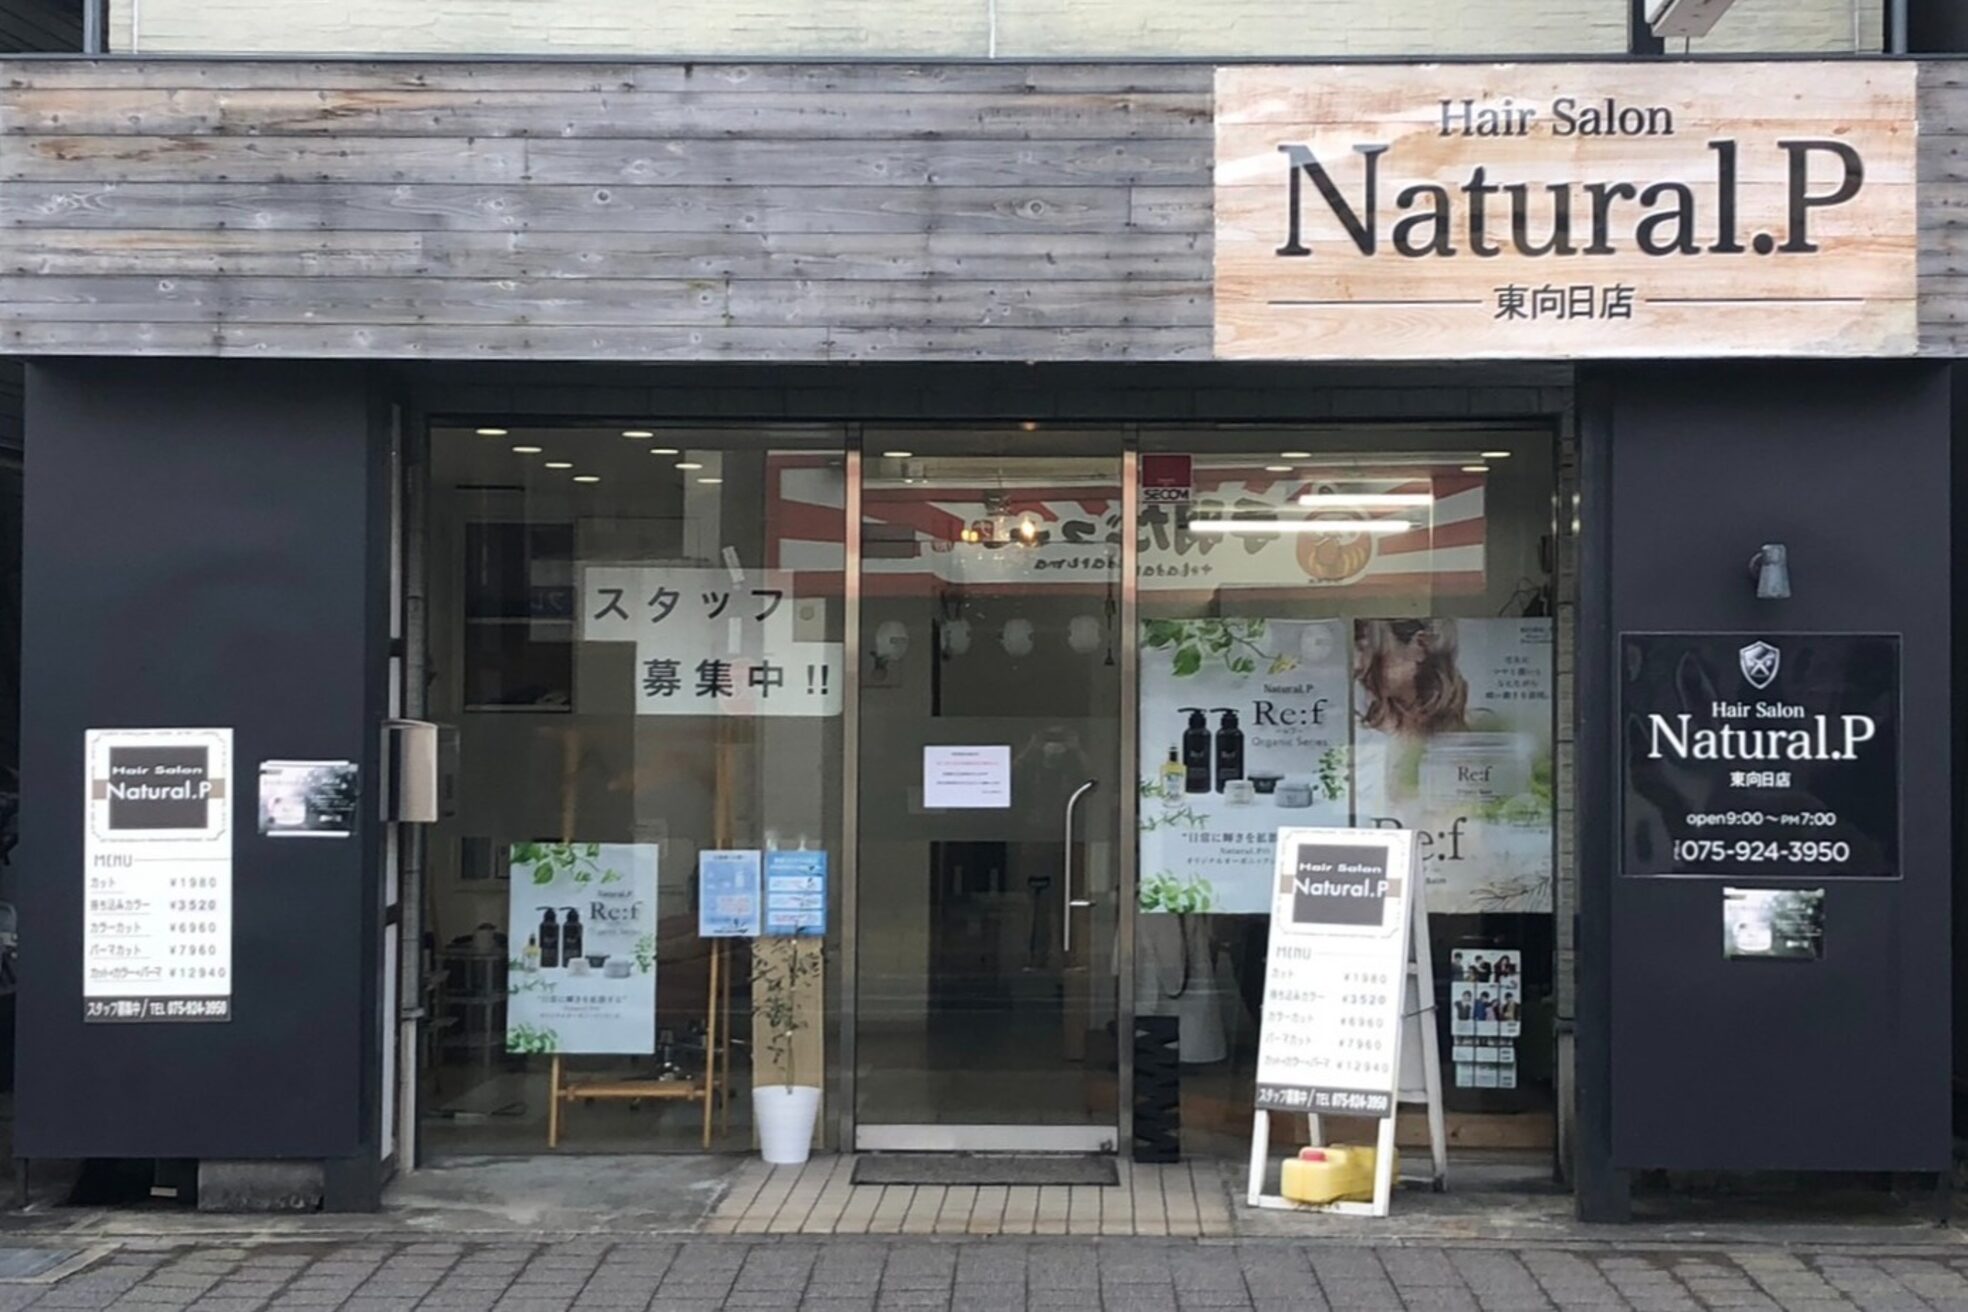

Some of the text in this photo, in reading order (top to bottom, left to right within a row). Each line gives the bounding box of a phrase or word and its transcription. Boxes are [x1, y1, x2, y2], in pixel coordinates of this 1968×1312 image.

[1440, 98, 1674, 137] Hair Salon
[1275, 139, 1865, 258] Natural.P
[1493, 284, 1635, 319] 東向日店
[594, 586, 783, 623] スタッフ
[1264, 684, 1314, 694] Natural.P
[1252, 698, 1328, 726] Re:f
[1712, 701, 1805, 718] Hair Salon
[1252, 737, 1293, 749] Organic
[1648, 714, 1875, 760] Natural.P
[112, 765, 203, 775] Hair Salon
[1458, 766, 1493, 782] Re:f
[1730, 771, 1791, 788] 東向日店
[107, 780, 213, 801] Natural.P
[1681, 840, 1850, 862] 075-924-3950
[94, 855, 132, 868] MENU
[1299, 863, 1383, 874] Hair Salon
[91, 878, 116, 888] カット
[1292, 877, 1390, 898] Natural.P
[590, 901, 643, 921] Re:f
[1276, 946, 1312, 960] MENU
